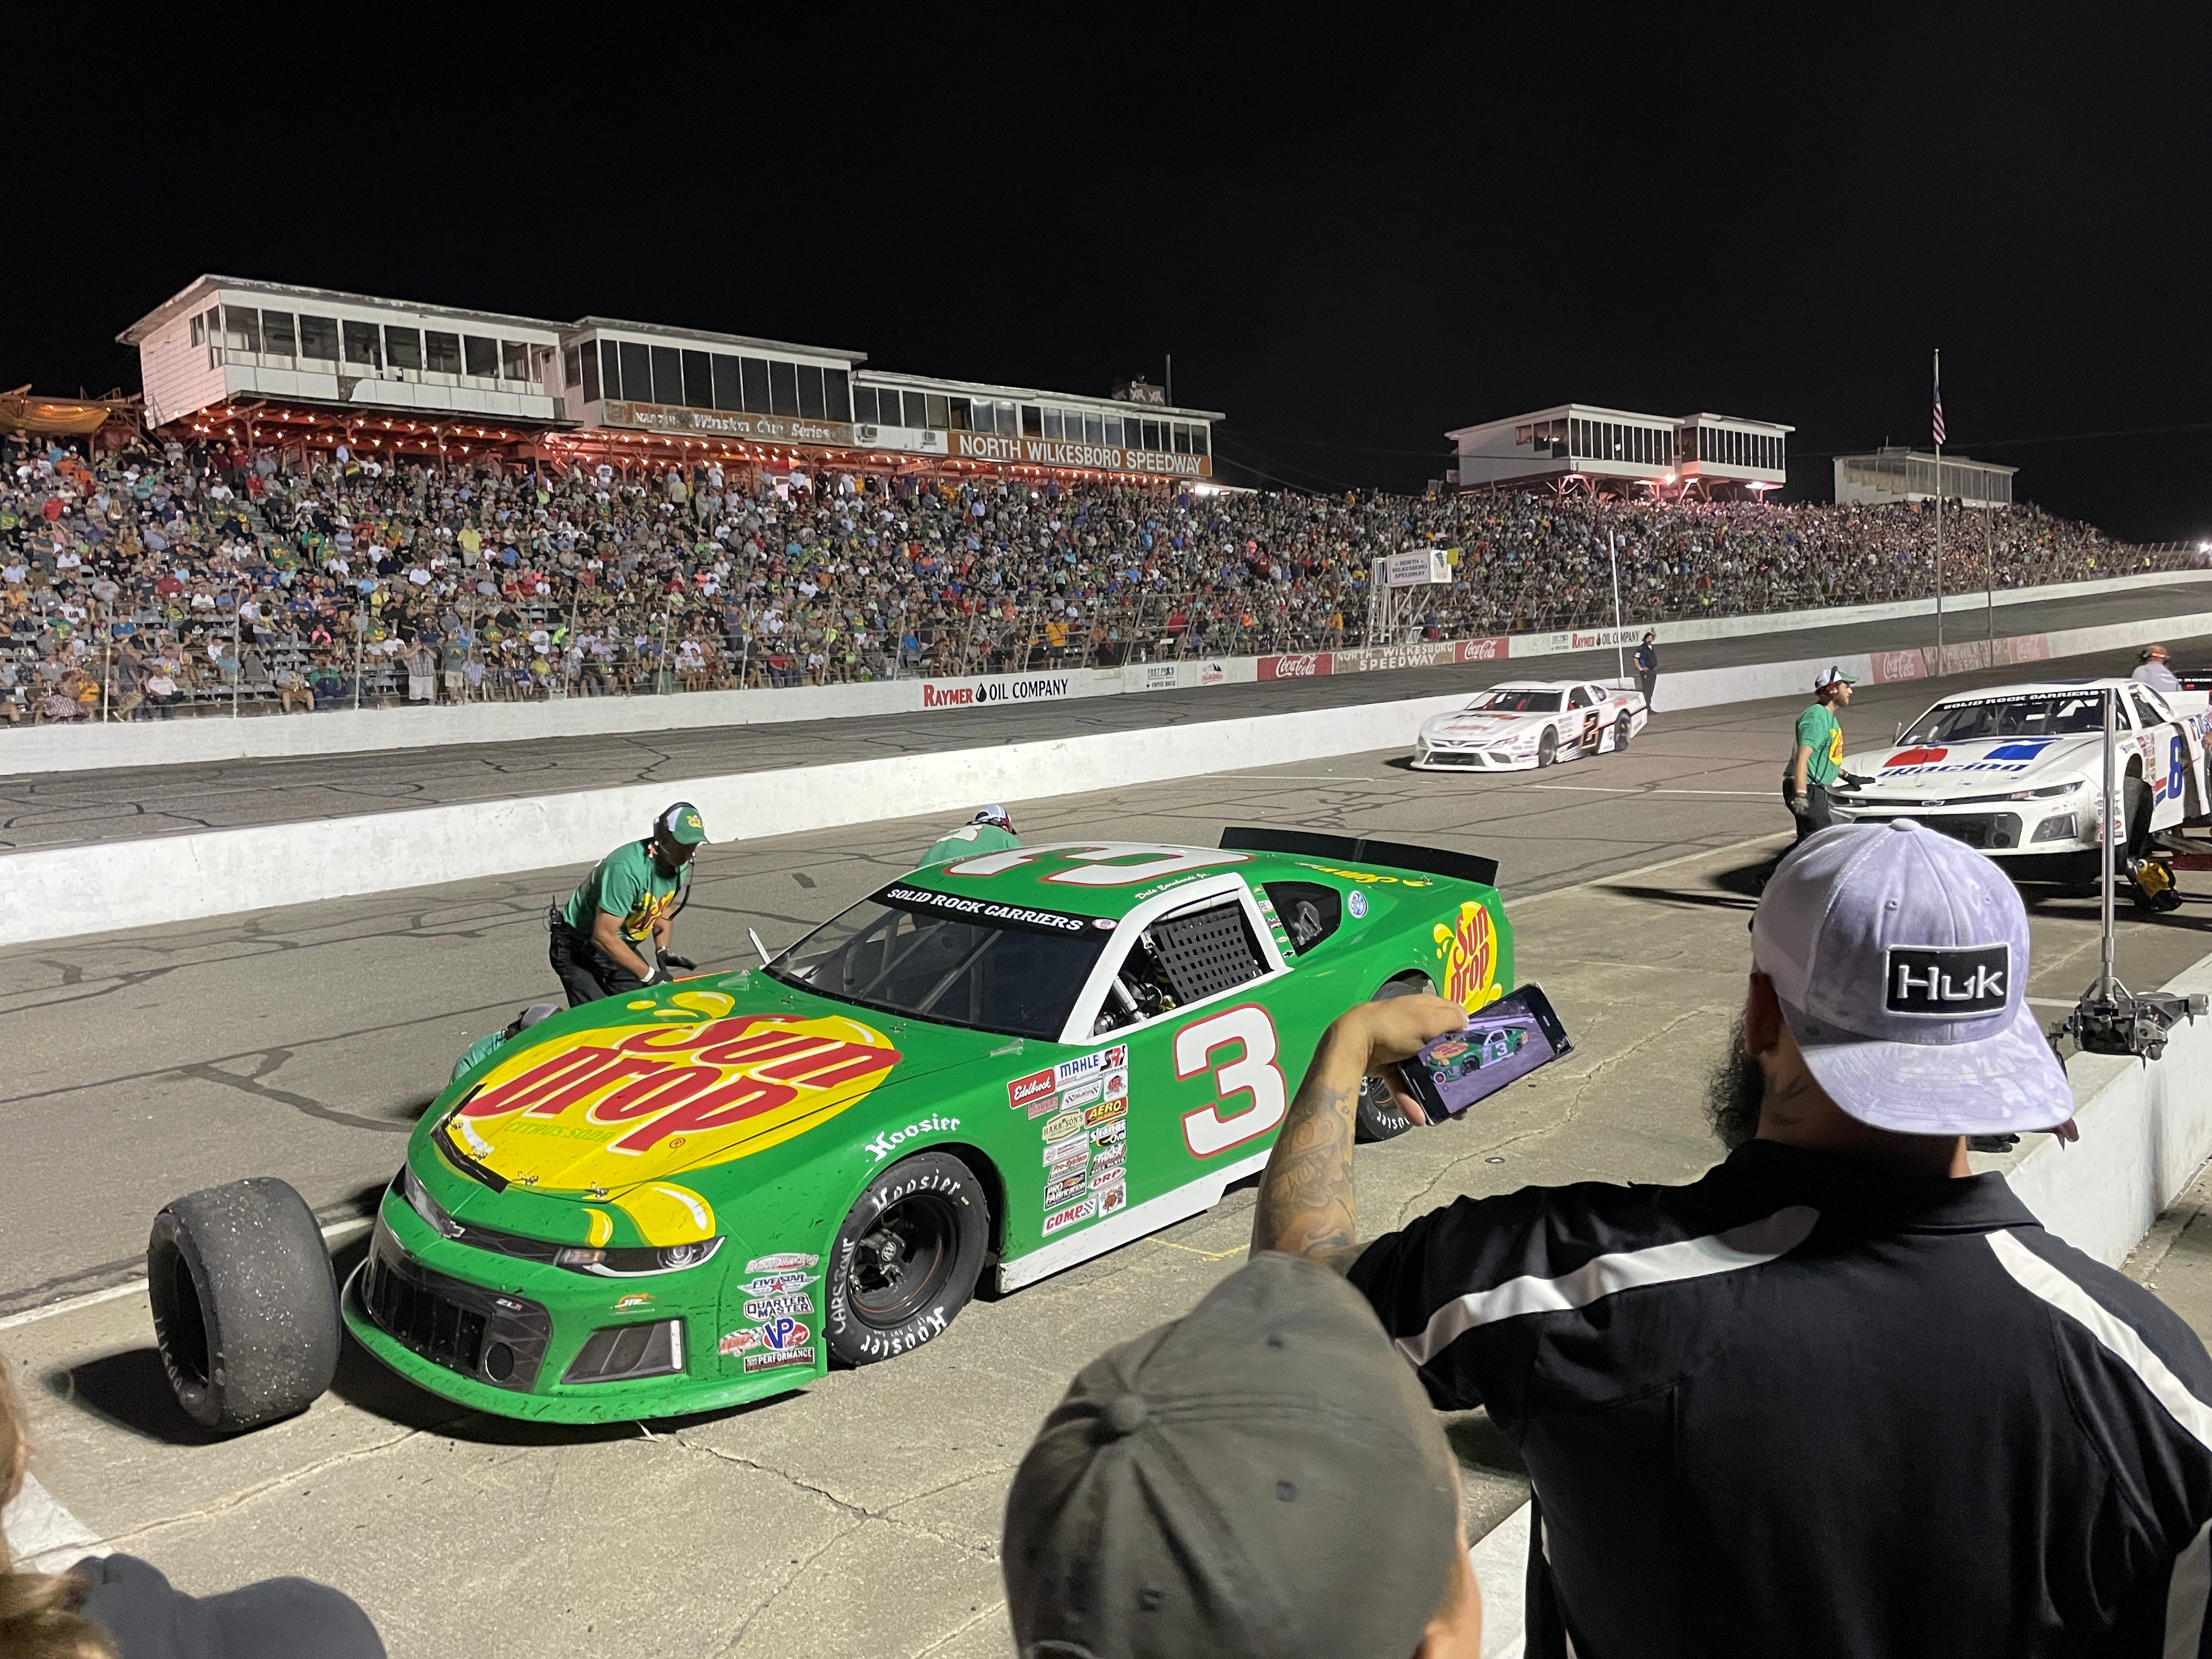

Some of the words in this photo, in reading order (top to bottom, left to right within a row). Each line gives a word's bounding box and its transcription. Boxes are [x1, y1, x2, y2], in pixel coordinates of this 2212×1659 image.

[960, 435, 1022, 459] NORTH
[1026, 441, 1121, 467] WILKESBORO
[1126, 450, 1201, 475] SPEEDWAY
[1392, 564, 1427, 573] WILKESBORO
[1395, 570, 1425, 579] SPEEDWAY
[1572, 633, 1595, 648] RAYMER
[1602, 633, 1611, 645] OIL
[1612, 631, 1640, 644] COMPANY
[1336, 650, 1372, 661] NORTH
[1383, 642, 1453, 657] WILKESBORO
[1359, 653, 1436, 671] SPEEDWAY
[923, 684, 973, 707] RAYMER
[989, 683, 1008, 701] OIL
[1012, 679, 1068, 698] COMPANY
[1943, 700, 1983, 710] SOLID
[1985, 695, 2027, 704] ROCK
[2029, 690, 2099, 699] CARRIERS
[2168, 736, 2184, 799] 8
[887, 888, 932, 903] SOLID
[930, 894, 986, 913] ROCK
[984, 904, 1084, 931] CARRIERS
[1453, 905, 1489, 972] Sun
[612, 1013, 903, 1089] Sun
[1495, 1042, 1508, 1057] 3
[1059, 1054, 1099, 1079] MAHLE
[1013, 1076, 1052, 1101] Edelbrock
[1172, 1001, 1288, 1160] 3
[1088, 1099, 1122, 1120] AERO
[503, 1121, 563, 1136] CITRUS
[565, 1127, 617, 1142] SODA
[865, 1112, 961, 1163] Hoosier
[1109, 1129, 1126, 1144] Oval
[1092, 1169, 1121, 1187] DRP
[872, 1168, 961, 1212] Hoosier
[1046, 1204, 1084, 1230] COMP
[753, 1277, 777, 1289] FIVE
[747, 1295, 806, 1314] QUARTER
[758, 1304, 809, 1318] MASTER
[764, 1318, 794, 1349] VP
[860, 1306, 947, 1357] Hoosier
[758, 1348, 812, 1365] PERFORMANCE
